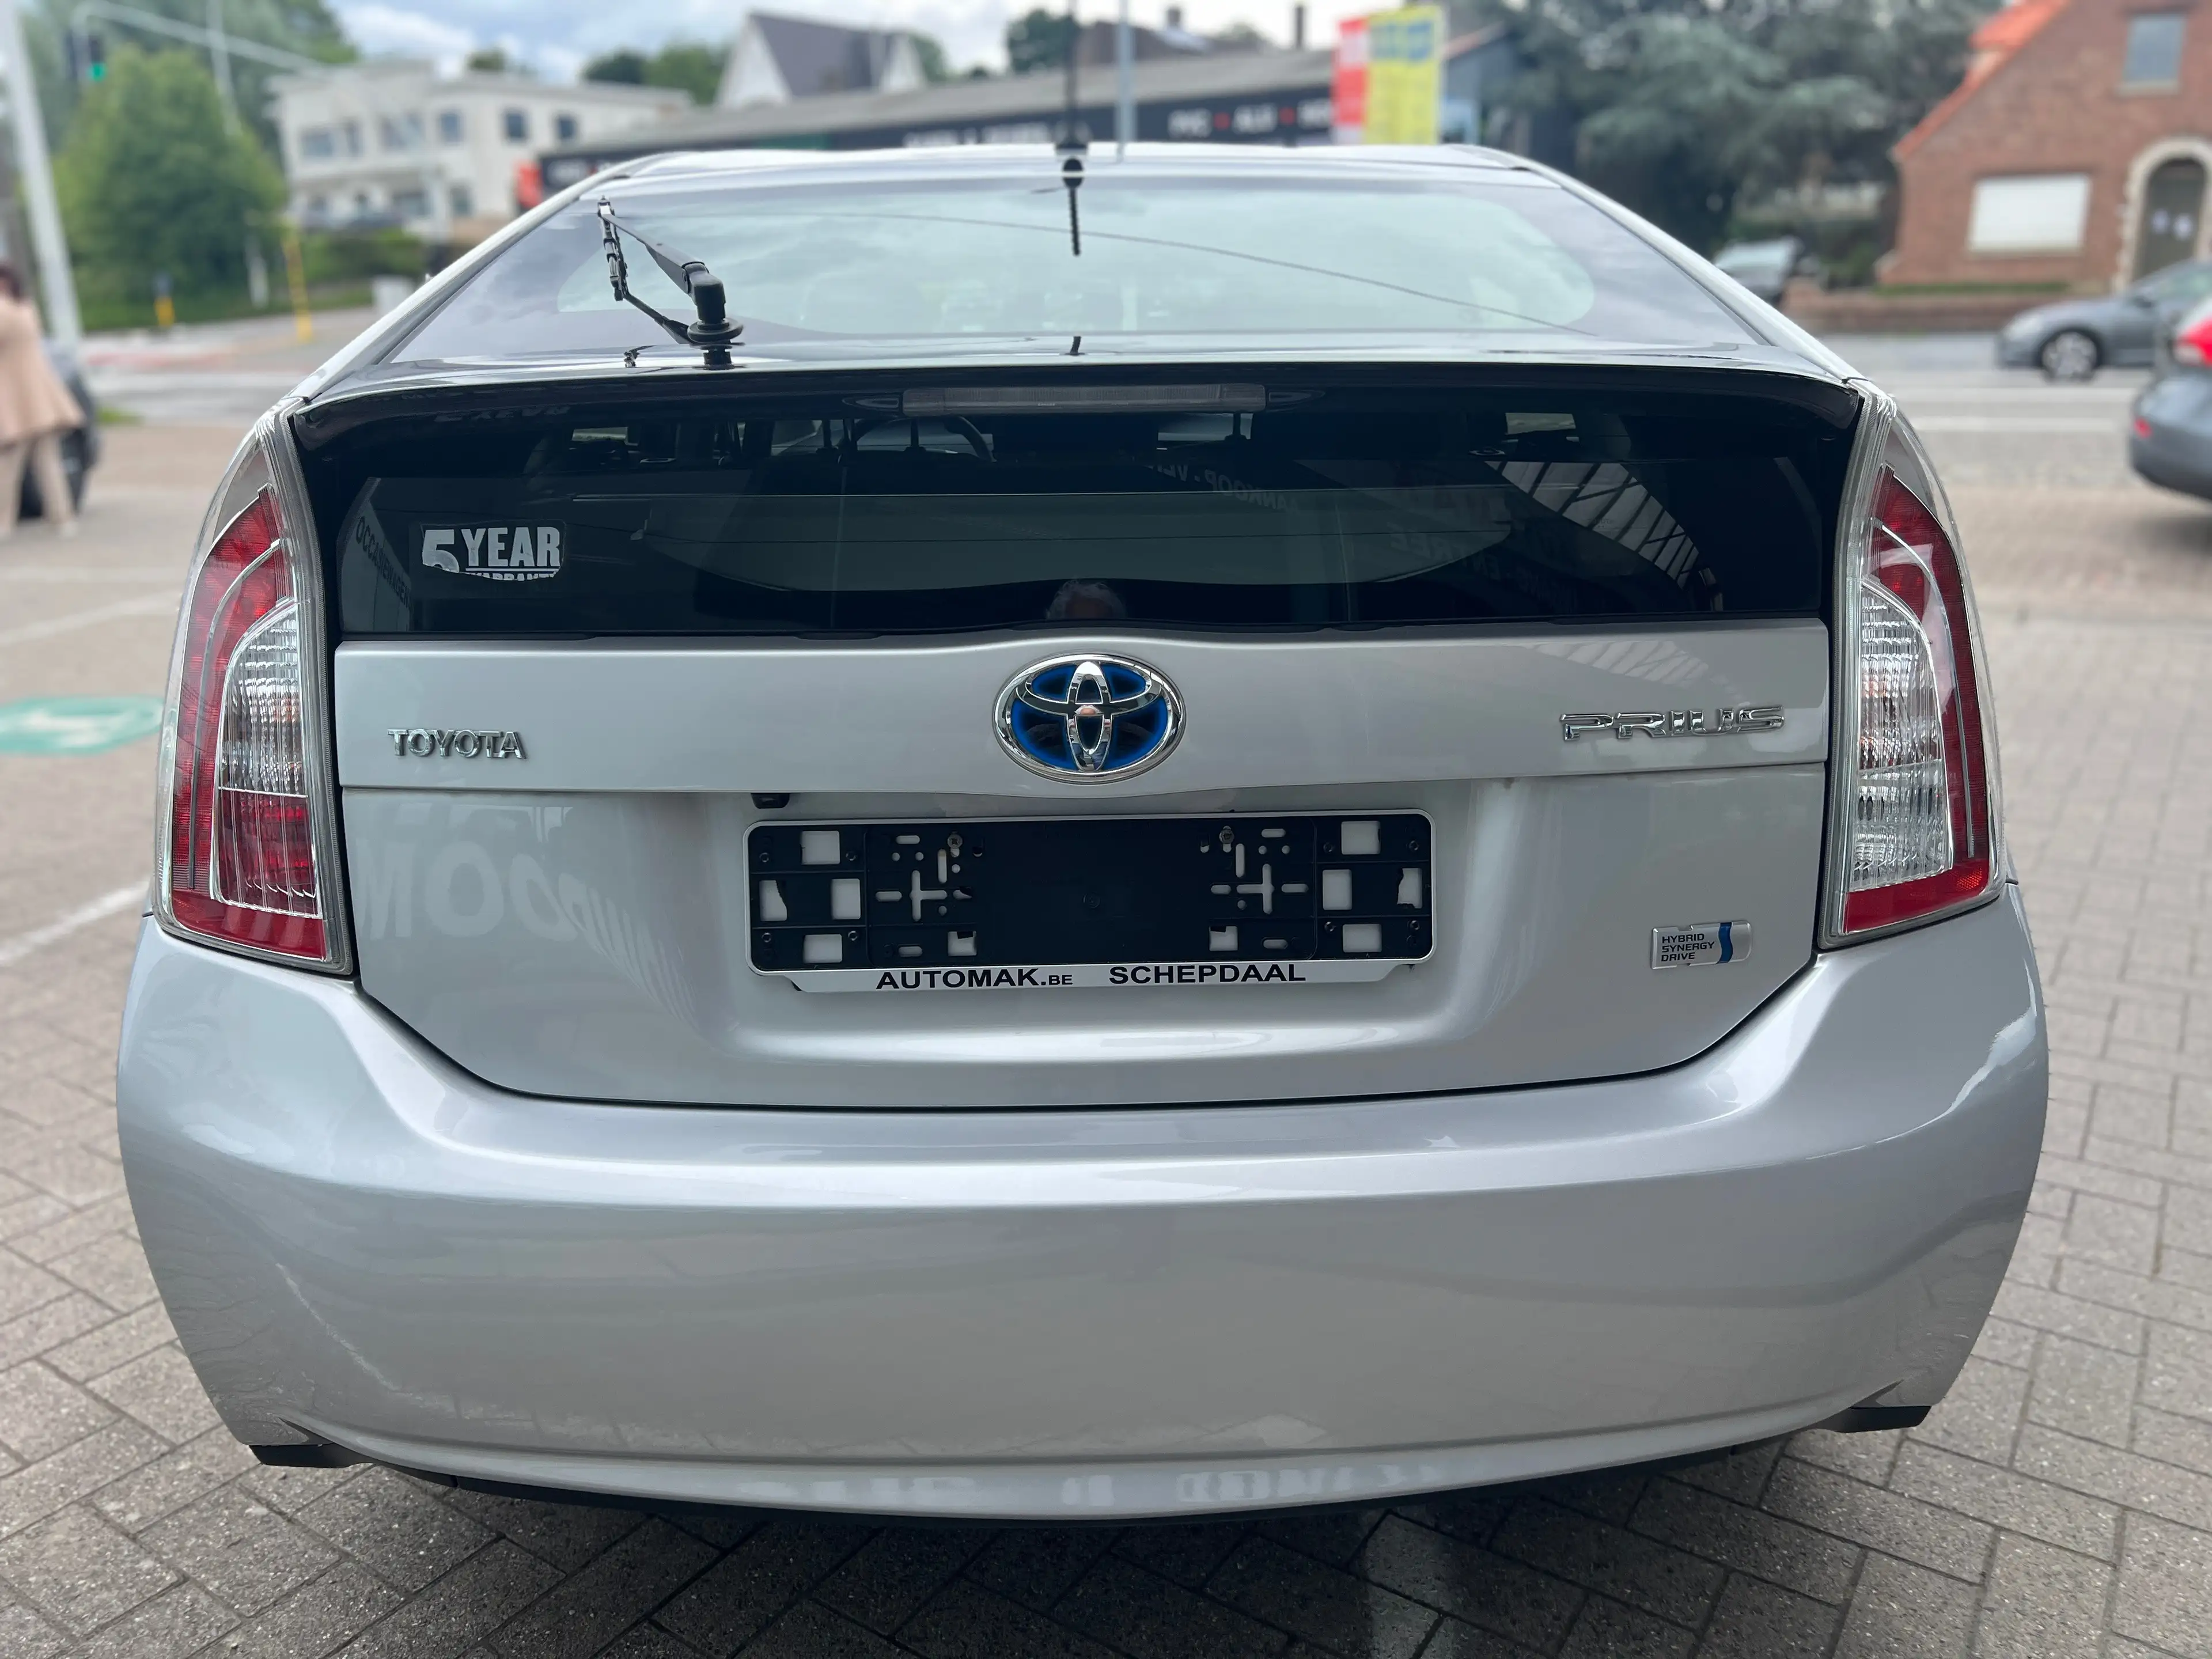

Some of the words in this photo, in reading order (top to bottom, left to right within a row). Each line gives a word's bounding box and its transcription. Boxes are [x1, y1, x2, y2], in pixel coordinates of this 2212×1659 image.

[422, 529, 460, 573] 5
[461, 527, 561, 567] YEAR
[1559, 704, 1786, 741] PRIUS
[387, 728, 527, 759] TOYOTA
[1661, 933, 1705, 944] HYBRID
[1661, 941, 1715, 953] SYNERGY
[1661, 952, 1696, 962] DRIVE
[876, 968, 1073, 990] AUTOMAK.BE
[1109, 964, 1306, 984] SCHEPDAAL
